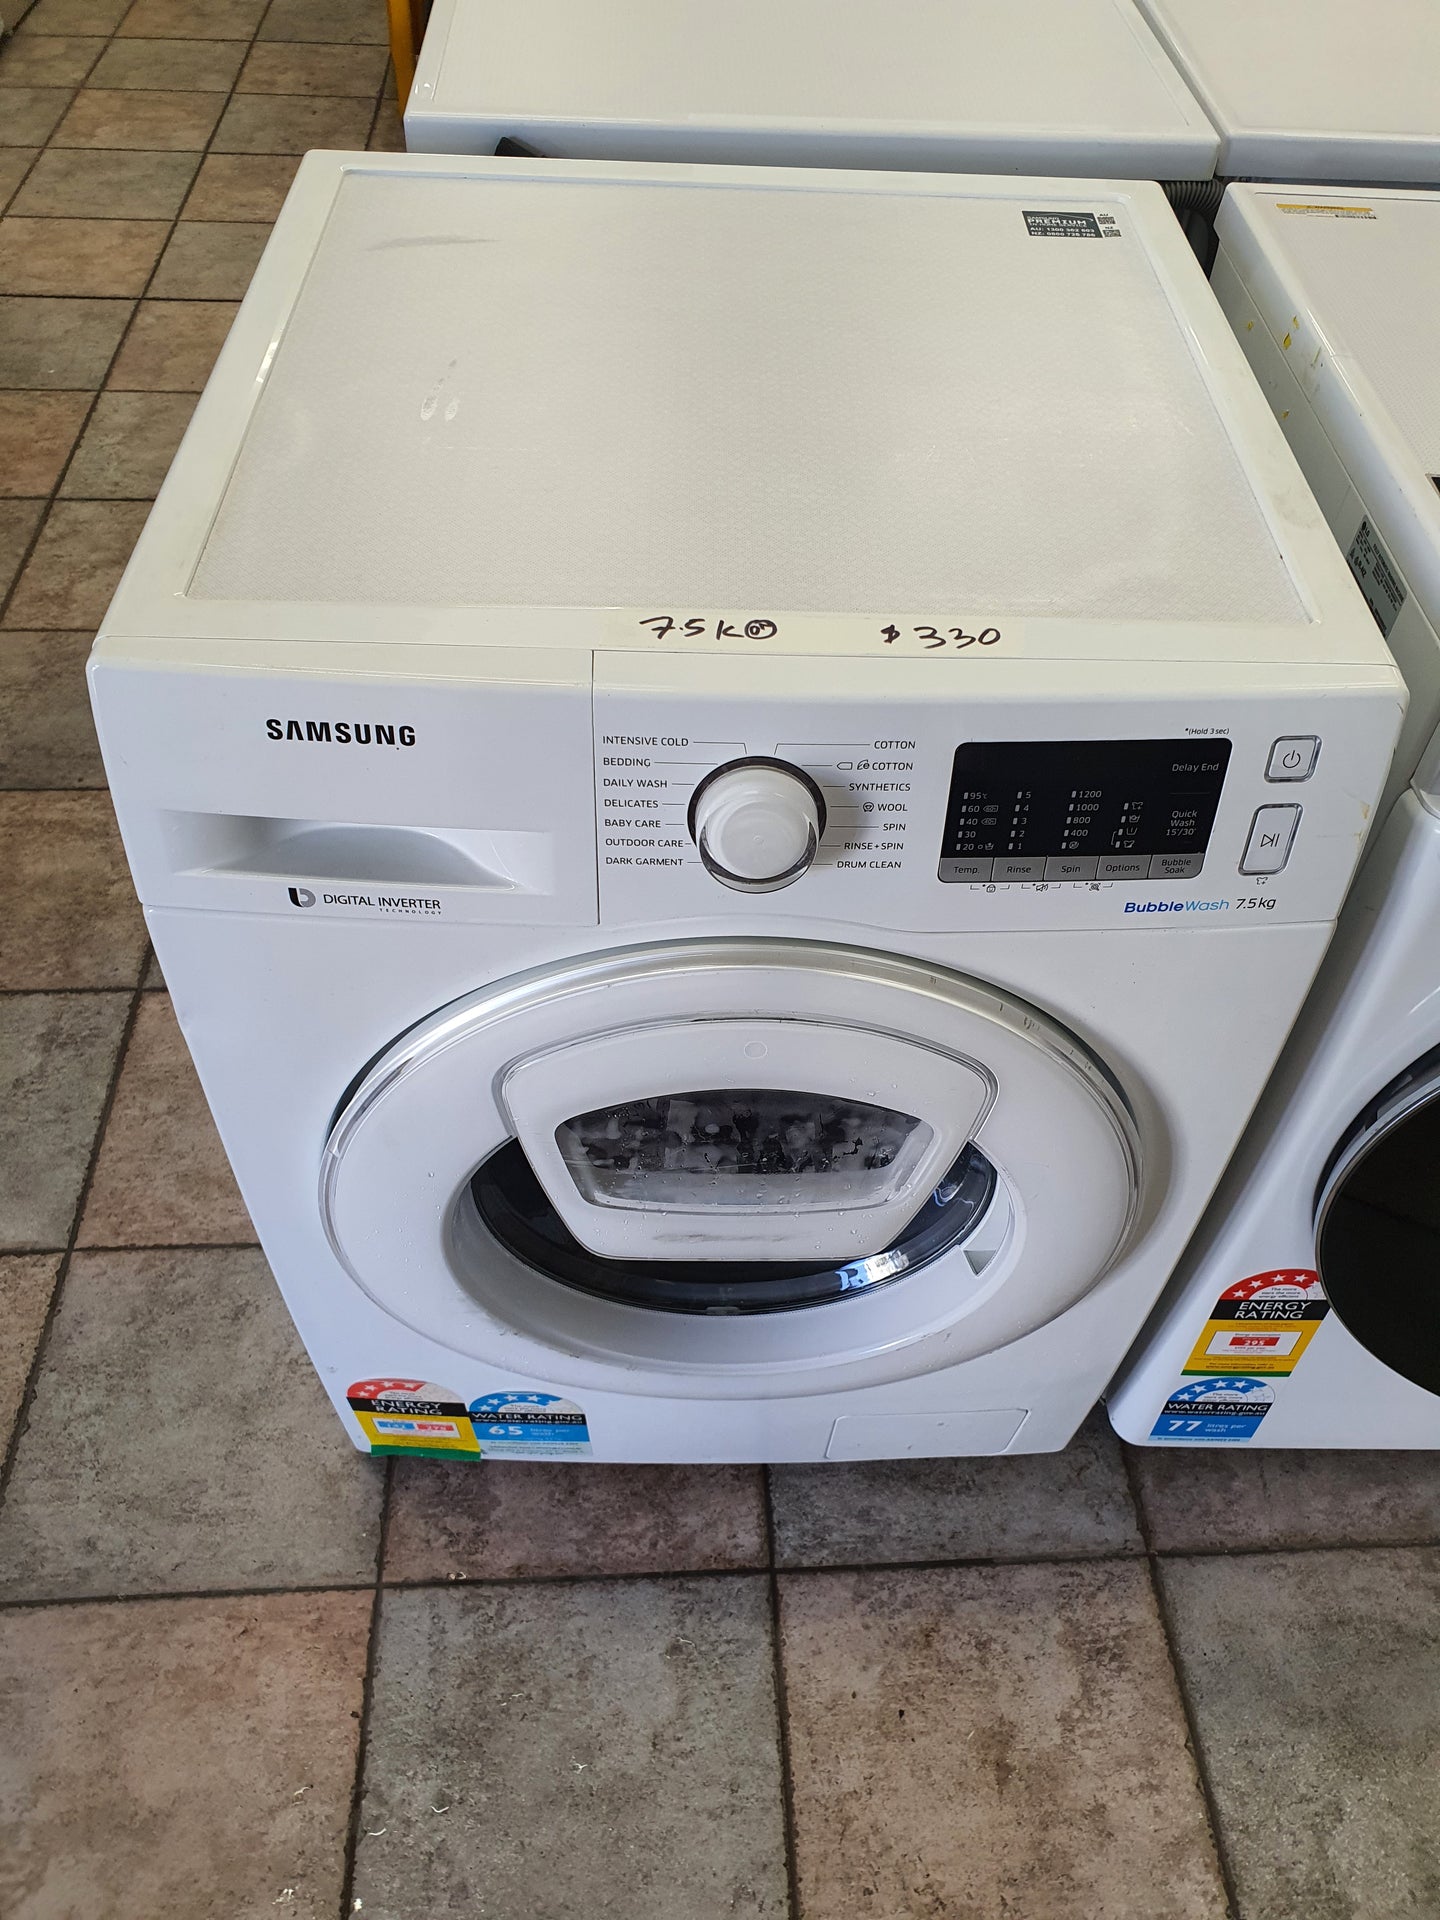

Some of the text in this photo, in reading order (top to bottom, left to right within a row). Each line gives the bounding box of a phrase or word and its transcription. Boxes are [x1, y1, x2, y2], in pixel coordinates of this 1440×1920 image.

[639, 616, 706, 640] 7.5
[913, 626, 1001, 649] 330
[265, 718, 416, 747] SAMSUNG
[602, 736, 689, 747] INTENSIVE COLD
[874, 740, 916, 749] COTTON
[603, 757, 651, 767] BEDDING
[872, 762, 914, 771] COTTON
[1172, 763, 1219, 772] Delay End
[603, 778, 668, 788] DAILY WASH
[848, 783, 911, 792] SYNTHETICS
[1025, 791, 1032, 799] 5
[1079, 790, 1102, 798] 1200
[604, 799, 659, 808] DELICATES
[877, 803, 908, 812] WOOL
[1023, 804, 1029, 812] 4
[1172, 810, 1198, 819] Quick
[604, 819, 661, 828] BABY CARE
[966, 818, 978, 826] 40
[1072, 816, 1091, 824] 800
[1170, 819, 1195, 827] Wash
[882, 823, 906, 831] SPIN
[1070, 829, 1089, 837] 400
[605, 838, 684, 848] OUTDOOR CARE
[843, 842, 873, 850] RINSE
[881, 842, 904, 850] SPIN
[962, 843, 975, 851] 20
[605, 857, 684, 866] DARK GARMENT
[836, 861, 902, 869] DRUM CLEAN
[1161, 858, 1192, 867] Bubble
[953, 866, 980, 875] Temp.
[1006, 866, 1032, 874] Rinse
[1061, 865, 1081, 873] Spin
[1105, 864, 1140, 873] Options
[1164, 866, 1186, 874] Soak
[323, 894, 441, 910] DIGITAL INVERTER
[1238, 1301, 1311, 1311] ENERGY
[1234, 1311, 1304, 1320] RATING
[371, 1399, 441, 1409] ENERGY
[1168, 1403, 1268, 1412] WATER RATING
[375, 1406, 443, 1416] RATING
[471, 1412, 583, 1421] WATER RATING
[488, 1425, 524, 1436] 65
[1168, 1420, 1203, 1432] 77
